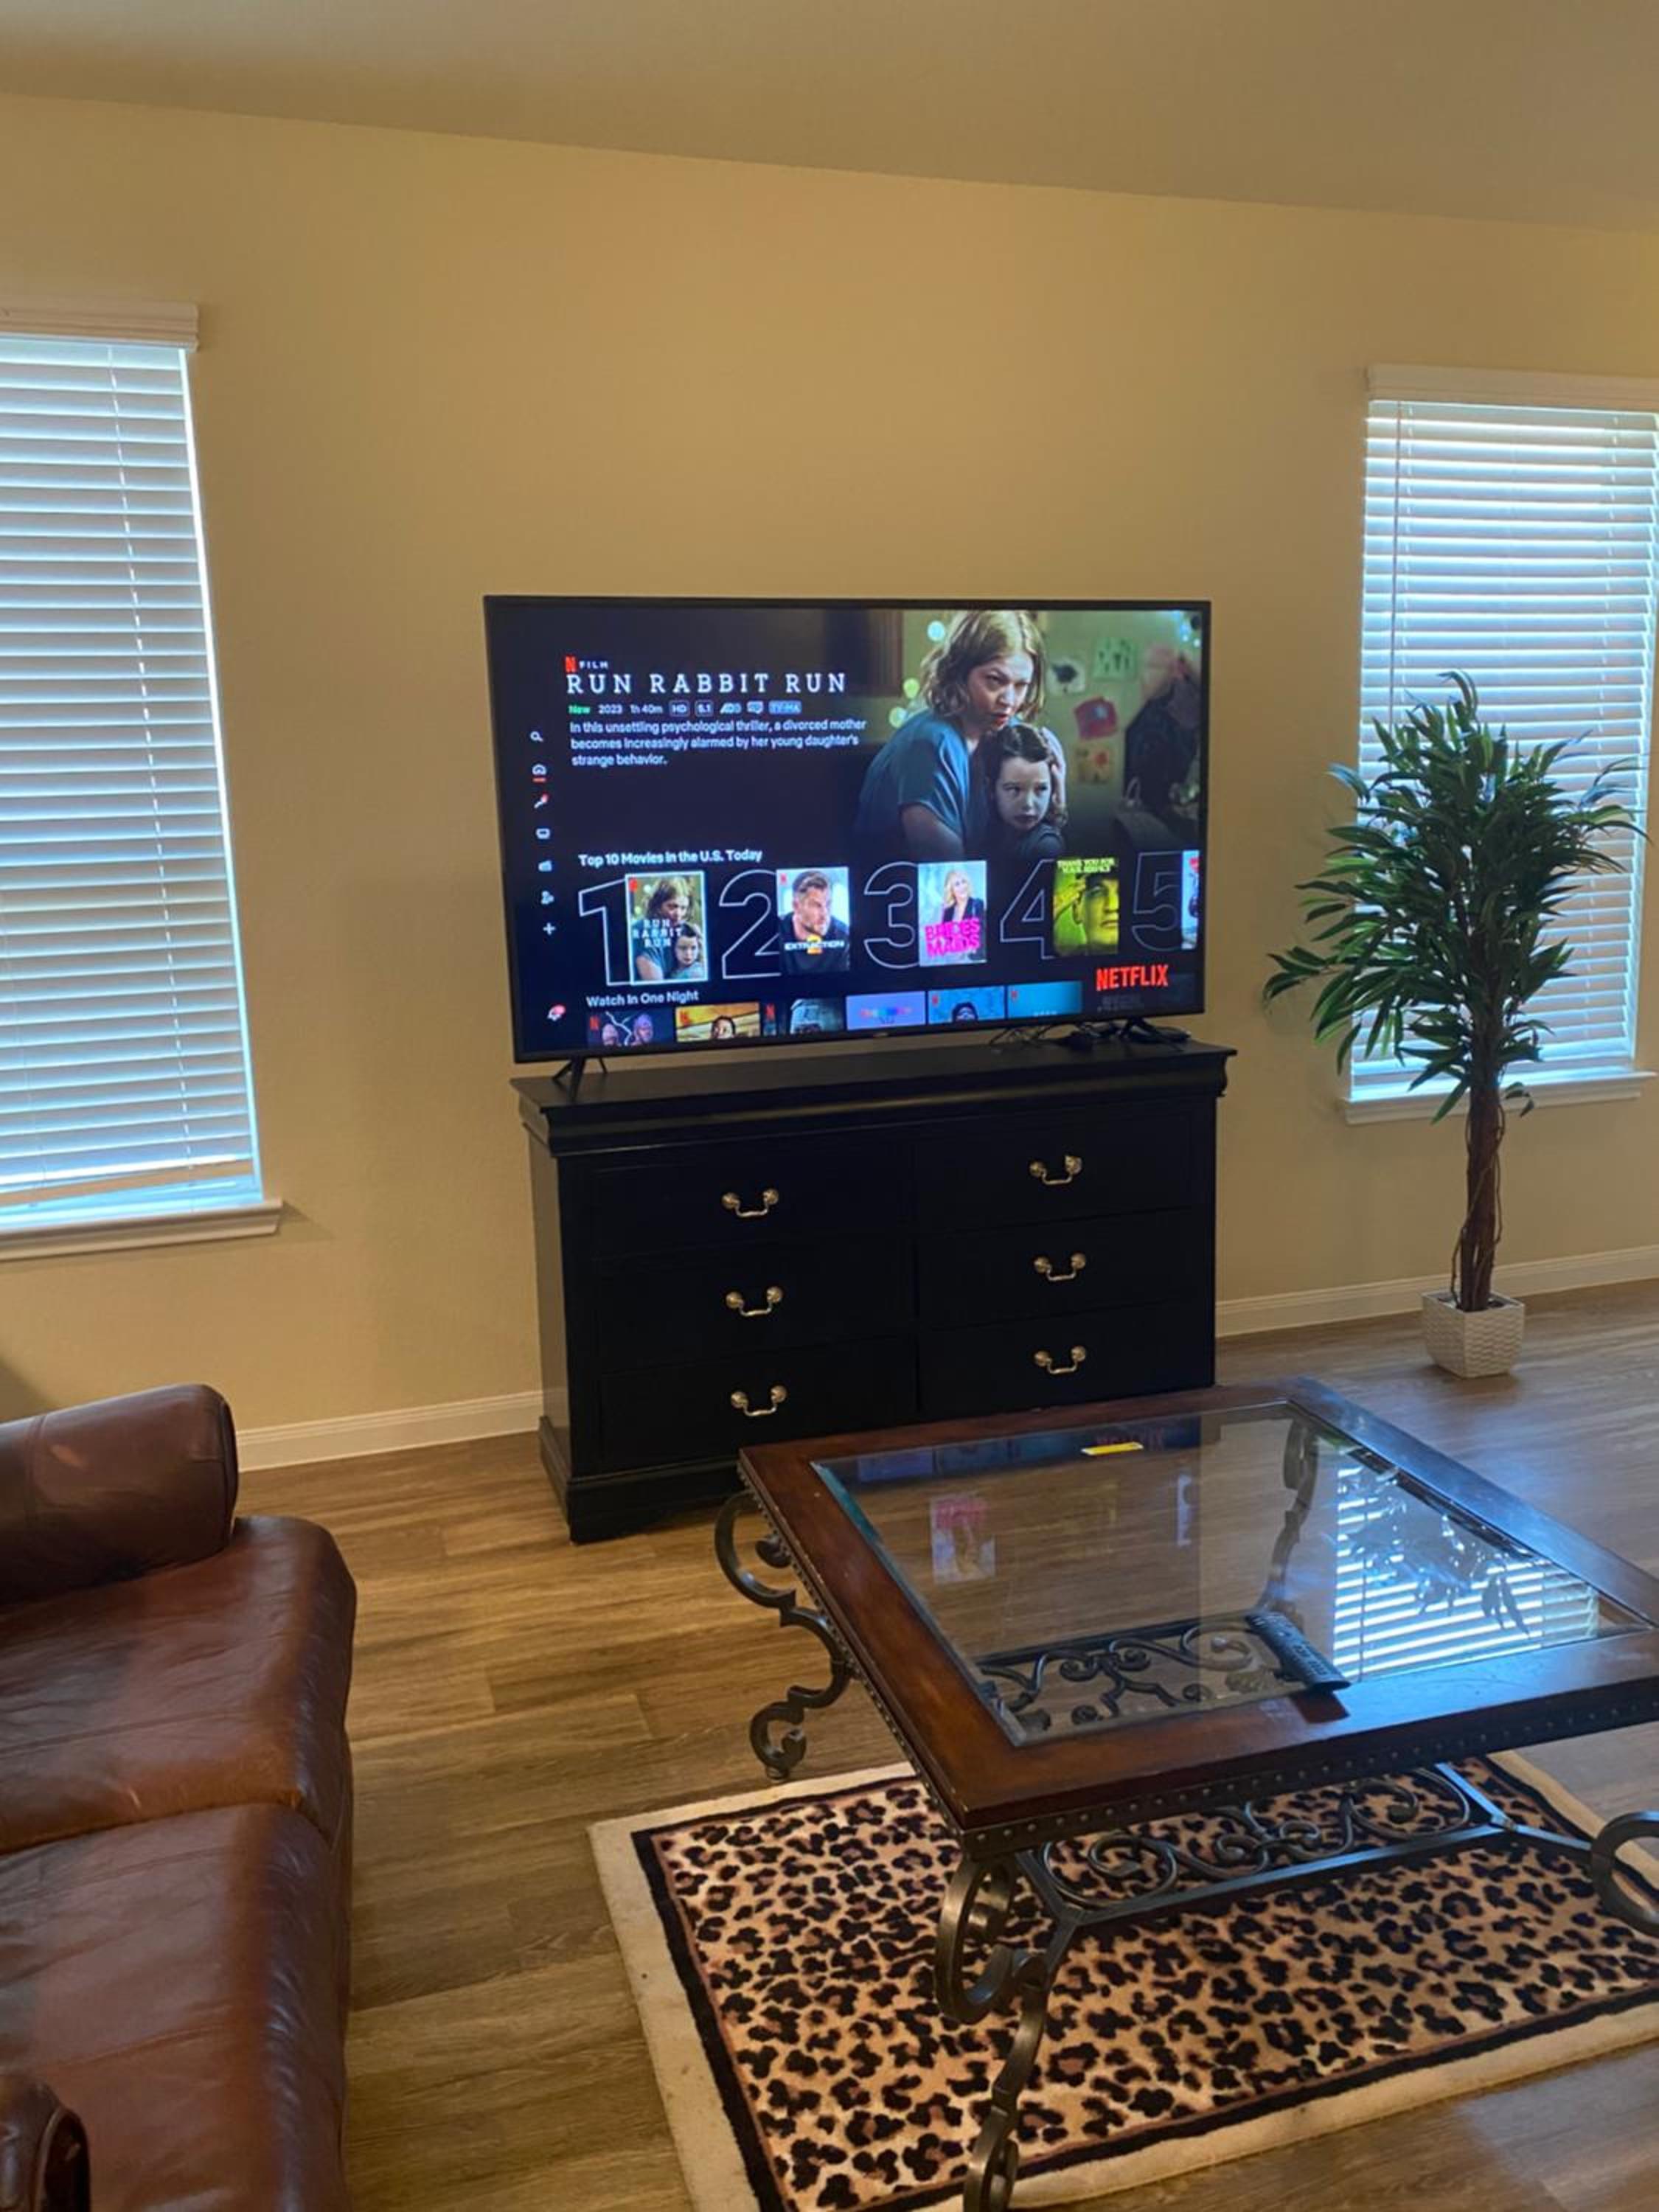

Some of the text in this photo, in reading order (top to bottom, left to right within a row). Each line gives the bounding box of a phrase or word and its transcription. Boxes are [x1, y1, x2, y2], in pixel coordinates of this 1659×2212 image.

[579, 661, 609, 669] FILM
[566, 672, 846, 694] RUN RABBIT RUN
[568, 705, 591, 714] New
[598, 703, 623, 714] 2023
[630, 703, 641, 714] 1h
[641, 703, 664, 714] 40m
[570, 722, 582, 734] In
[582, 721, 604, 734] this
[605, 721, 660, 735] unsettling
[661, 720, 734, 734] psychological
[737, 719, 773, 733] thriller,
[783, 719, 828, 730] divorced
[830, 719, 866, 730] mother
[571, 734, 859, 751] becomes increasingly alarmed by her young daughter's
[571, 753, 668, 768] strange behavior.
[578, 854, 603, 868] Top
[605, 853, 619, 865] 10
[621, 852, 664, 864] Movies
[679, 851, 698, 862] the
[700, 850, 724, 862] U.S.
[726, 849, 763, 862] Today
[999, 859, 1055, 960] 4
[1132, 851, 1183, 952] 5
[719, 869, 782, 979] 2
[863, 860, 919, 969] 3
[578, 877, 632, 986] 1
[1096, 964, 1169, 991] NETFLIX
[586, 995, 625, 1007] Watch
[641, 993, 664, 1004] One
[666, 991, 699, 1004] Night
